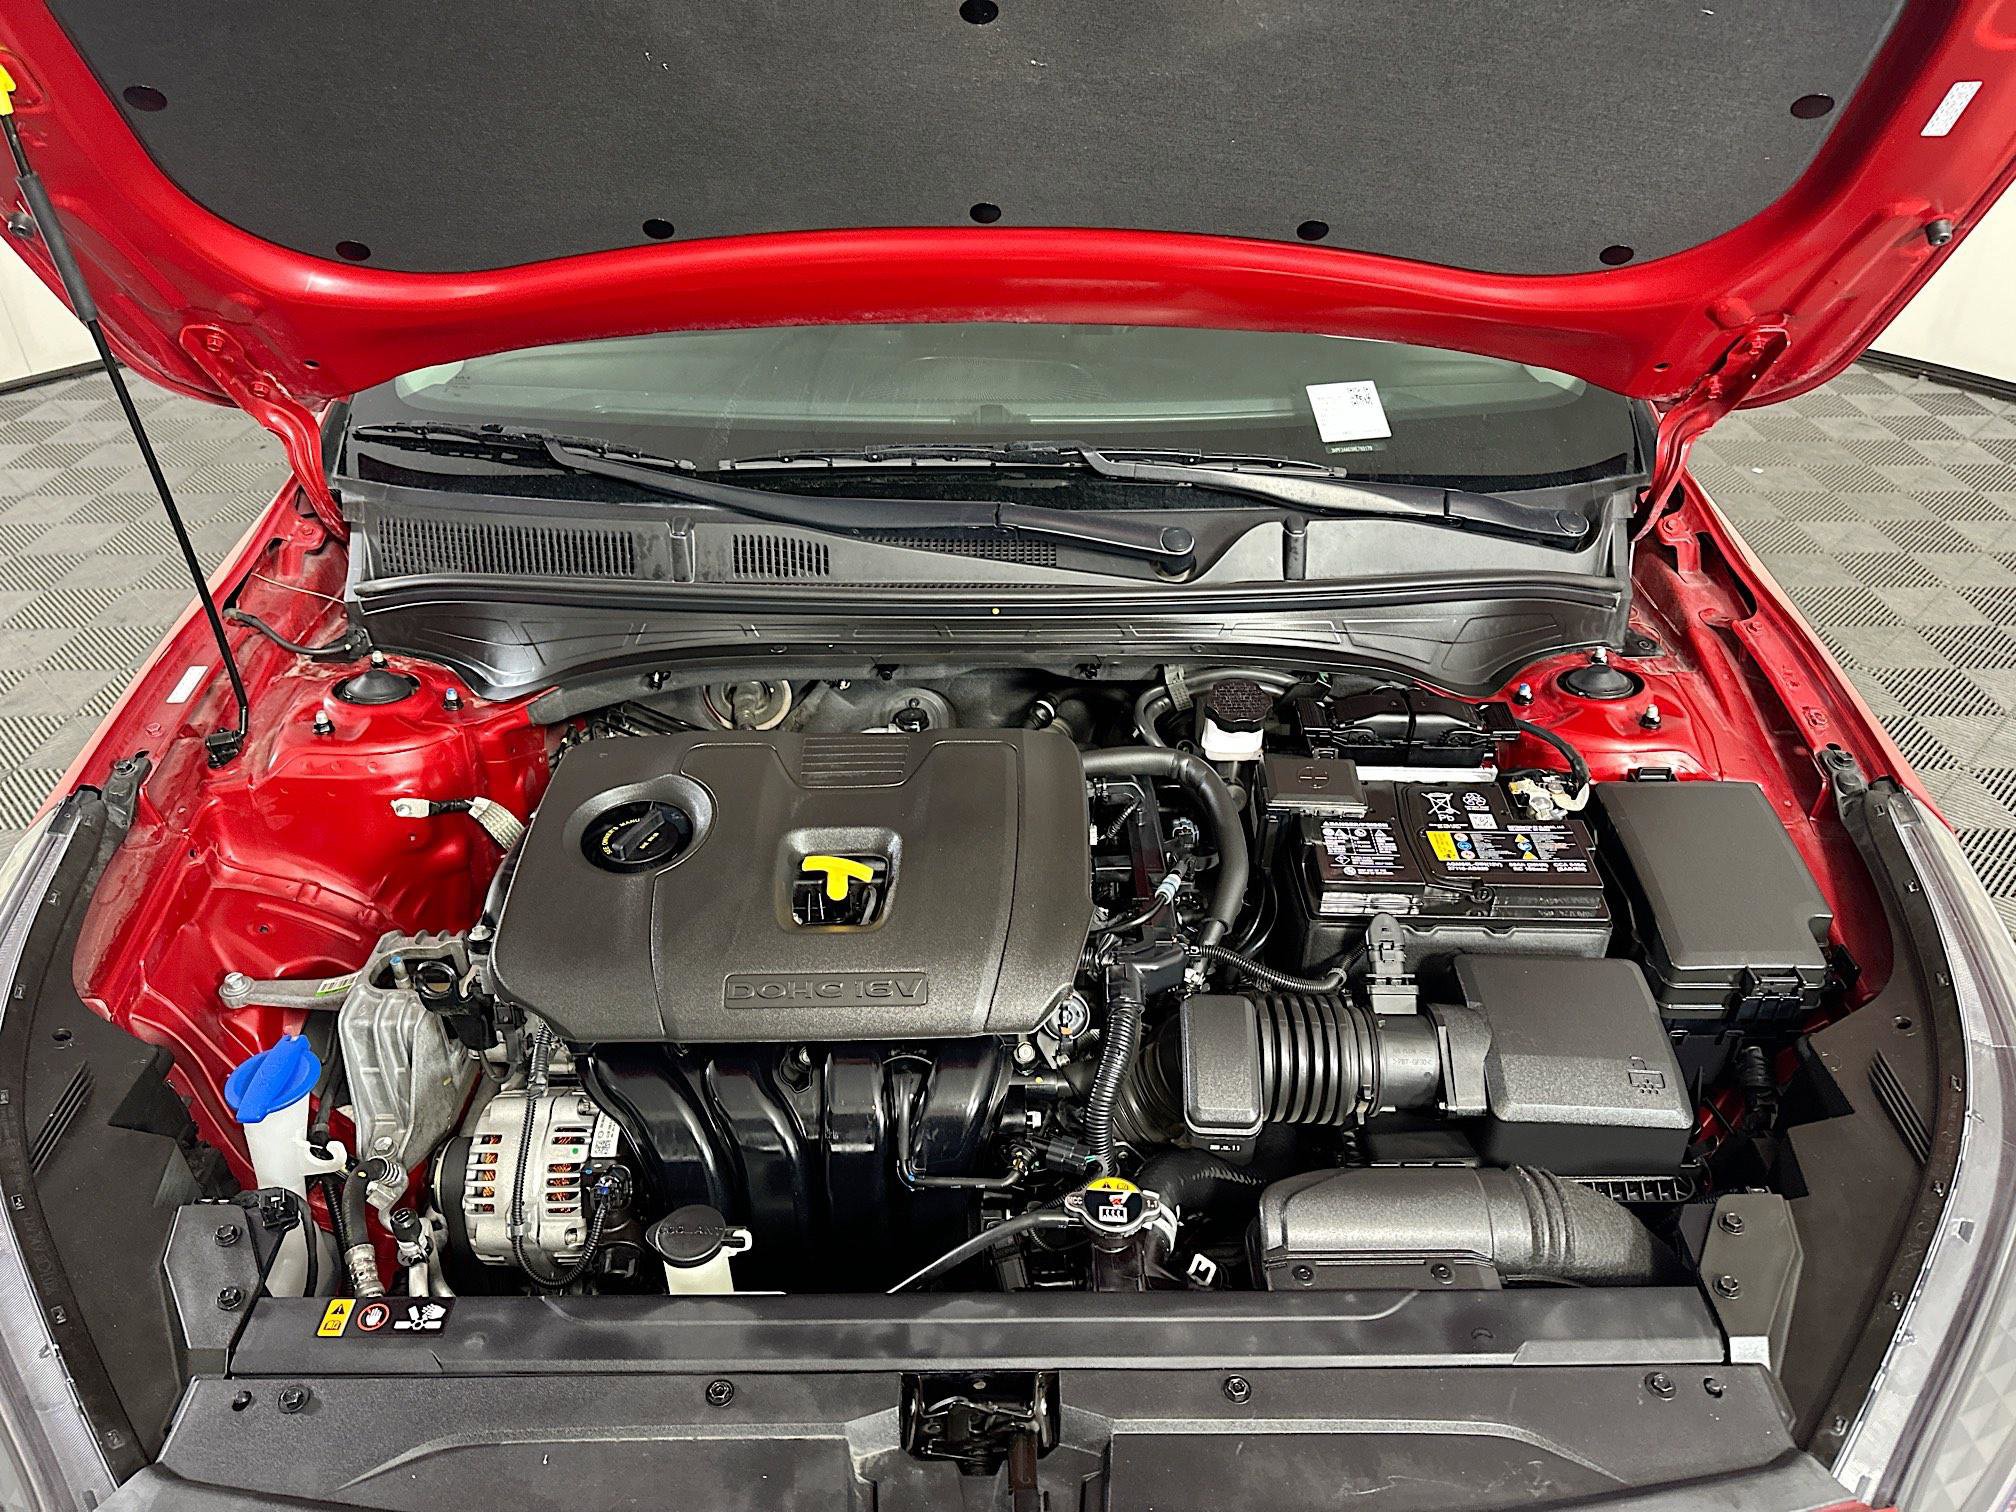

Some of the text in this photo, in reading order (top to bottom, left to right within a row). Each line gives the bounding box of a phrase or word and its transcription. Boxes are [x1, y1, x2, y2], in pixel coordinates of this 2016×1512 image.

[619, 818, 640, 827] MANU
[1437, 814, 1455, 822] Pb
[727, 978, 923, 1000] DOHC 16V
